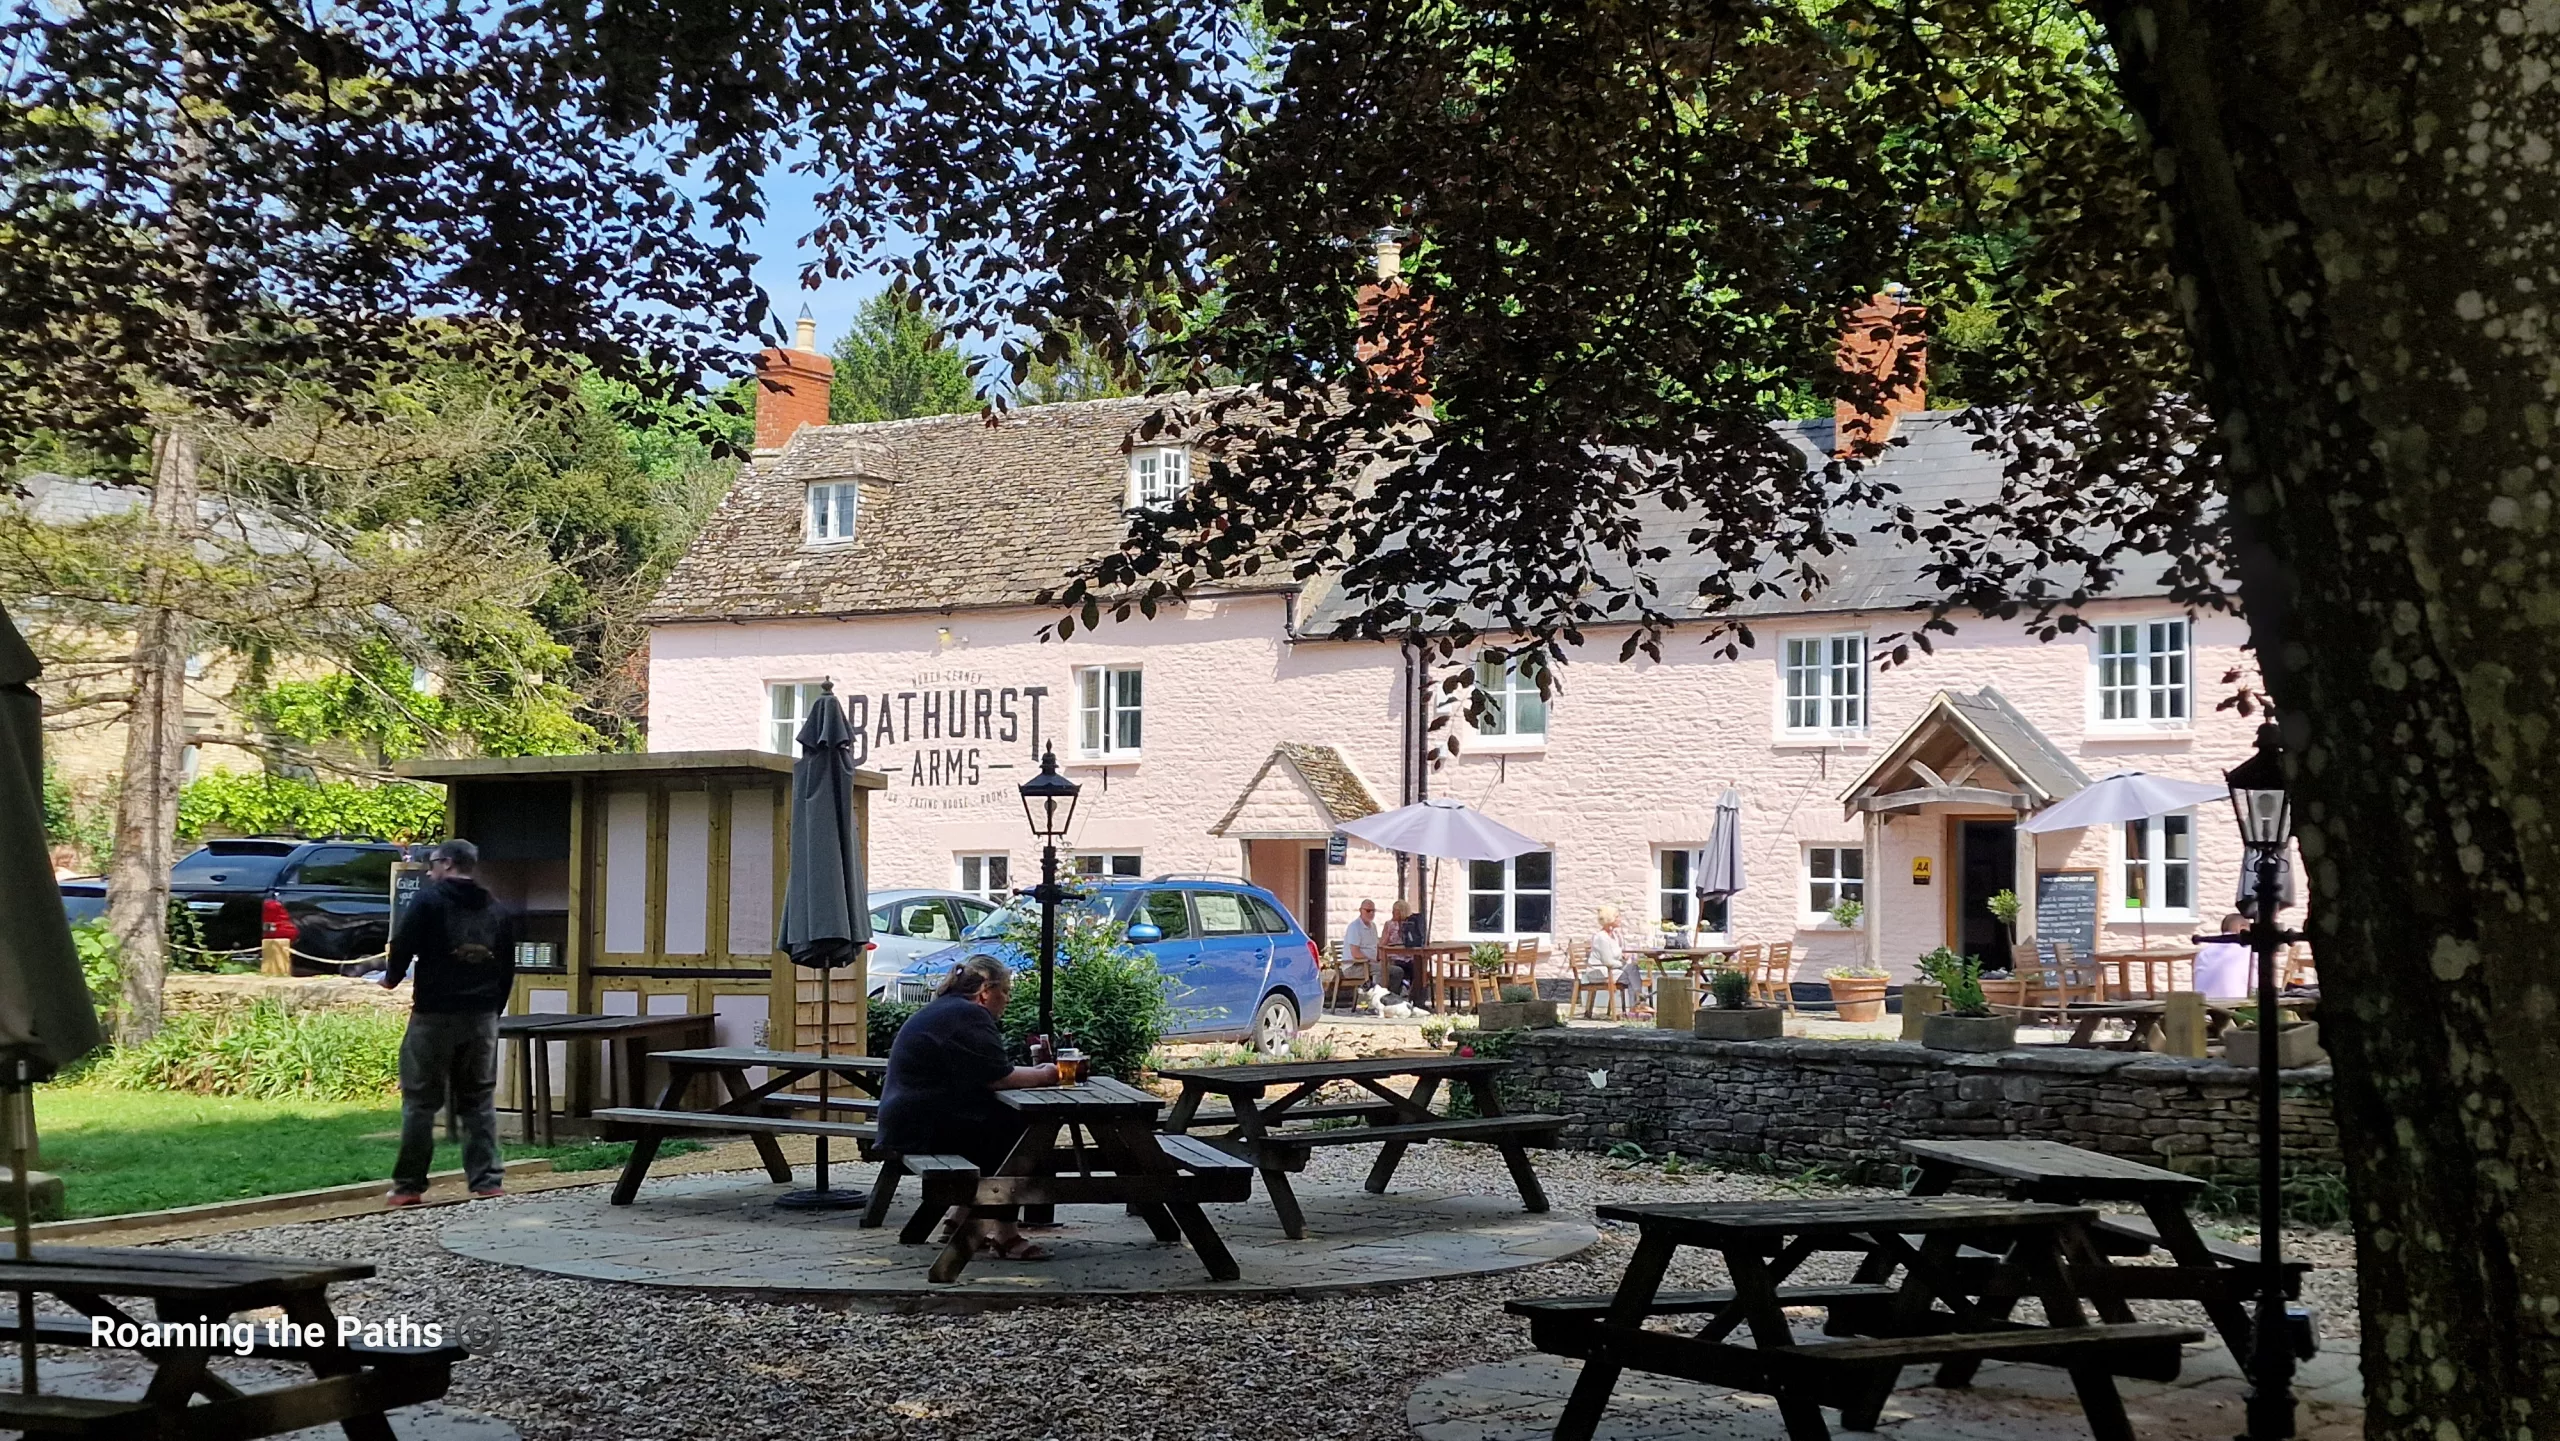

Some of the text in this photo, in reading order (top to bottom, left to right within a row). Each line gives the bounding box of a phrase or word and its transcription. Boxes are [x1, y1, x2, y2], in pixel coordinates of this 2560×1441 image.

[848, 686, 1049, 767] BATHURST
[911, 748, 981, 787] ARMS
[980, 788, 1009, 804] ROOMS
[1915, 861, 1929, 872] AA
